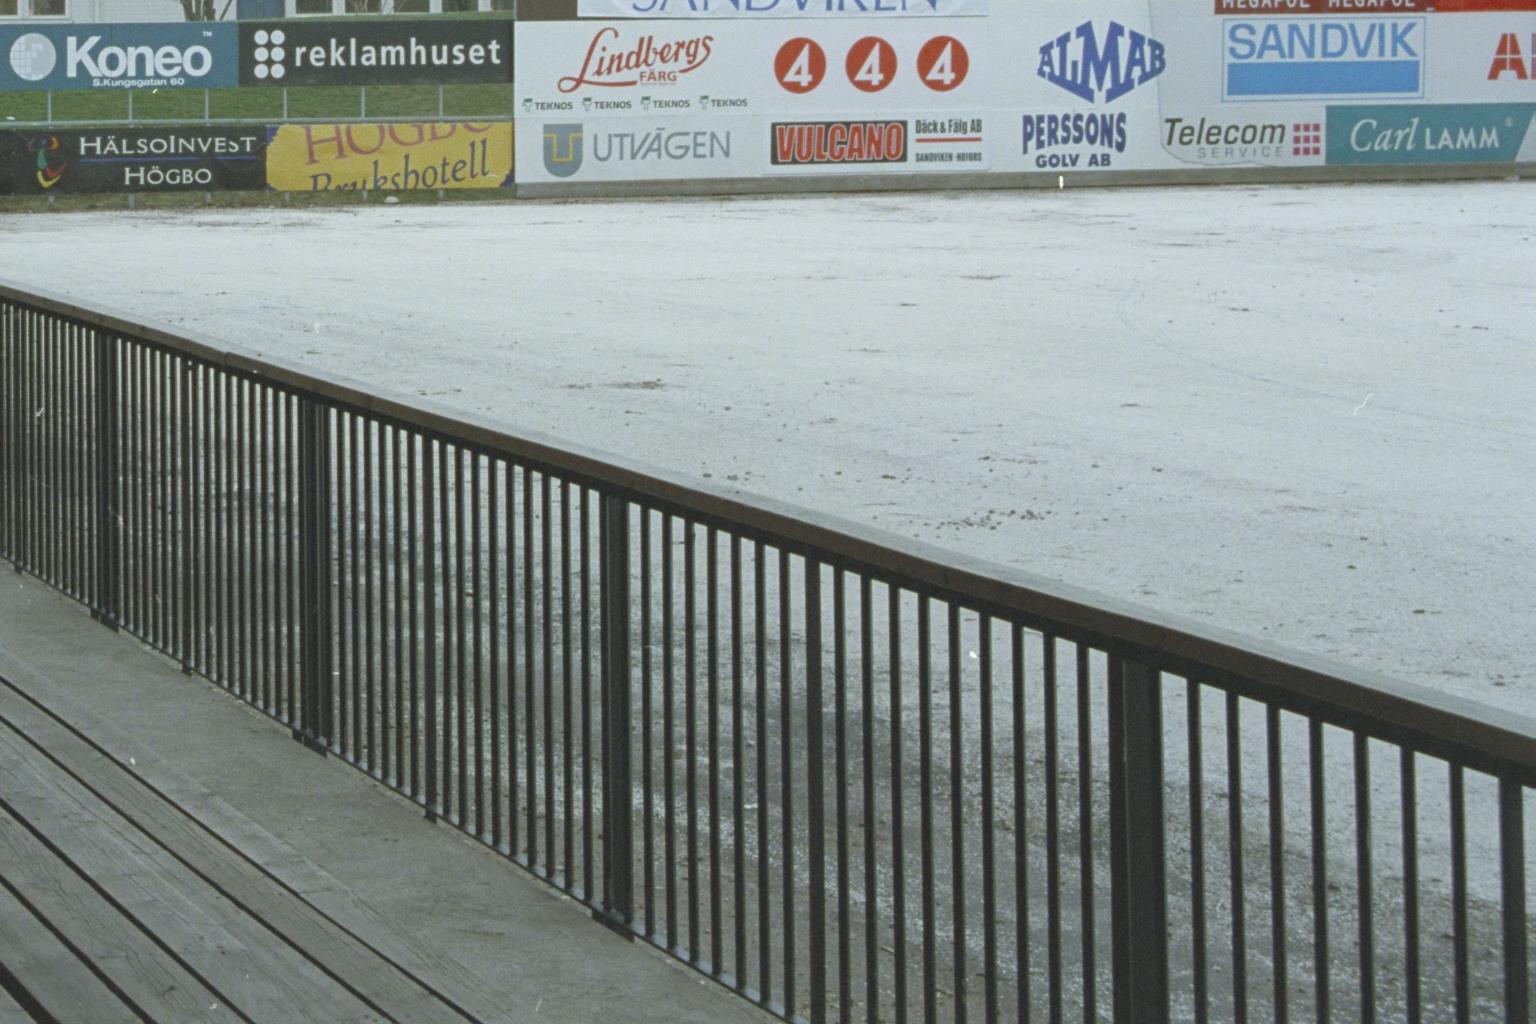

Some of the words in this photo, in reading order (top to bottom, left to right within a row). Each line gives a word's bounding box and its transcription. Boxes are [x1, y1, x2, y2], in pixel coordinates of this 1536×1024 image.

[66, 36, 213, 78] Koneo
[295, 38, 501, 67] reklamhuset
[1228, 22, 1418, 60] SANDVIK
[1487, 33, 1536, 81] A
[558, 27, 714, 93] Lindbergs
[639, 69, 677, 82] FÄRG
[783, 43, 813, 87] 4
[854, 42, 884, 85] 4
[925, 41, 956, 85] 4
[1037, 20, 1166, 104] ALMAB
[92, 78, 167, 88] S.Kungsgatan
[170, 78, 185, 86] 60
[535, 101, 573, 111] TEKNOS
[595, 100, 632, 110] TEKNOS
[653, 99, 690, 109] TEKNOS
[711, 98, 748, 108] TEKNOS
[776, 122, 904, 162] VULCANO
[915, 119, 938, 134] Däck
[970, 118, 982, 133] AB
[1022, 112, 1127, 155] PERSSONS
[1164, 117, 1286, 146] Telecom
[1350, 117, 1420, 152] Carl
[1425, 126, 1500, 150] LAMM
[1035, 154, 1080, 169] GOLV
[1088, 153, 1111, 167] AB
[1197, 145, 1284, 159] SERVICE
[124, 166, 212, 185] HÖGBO
